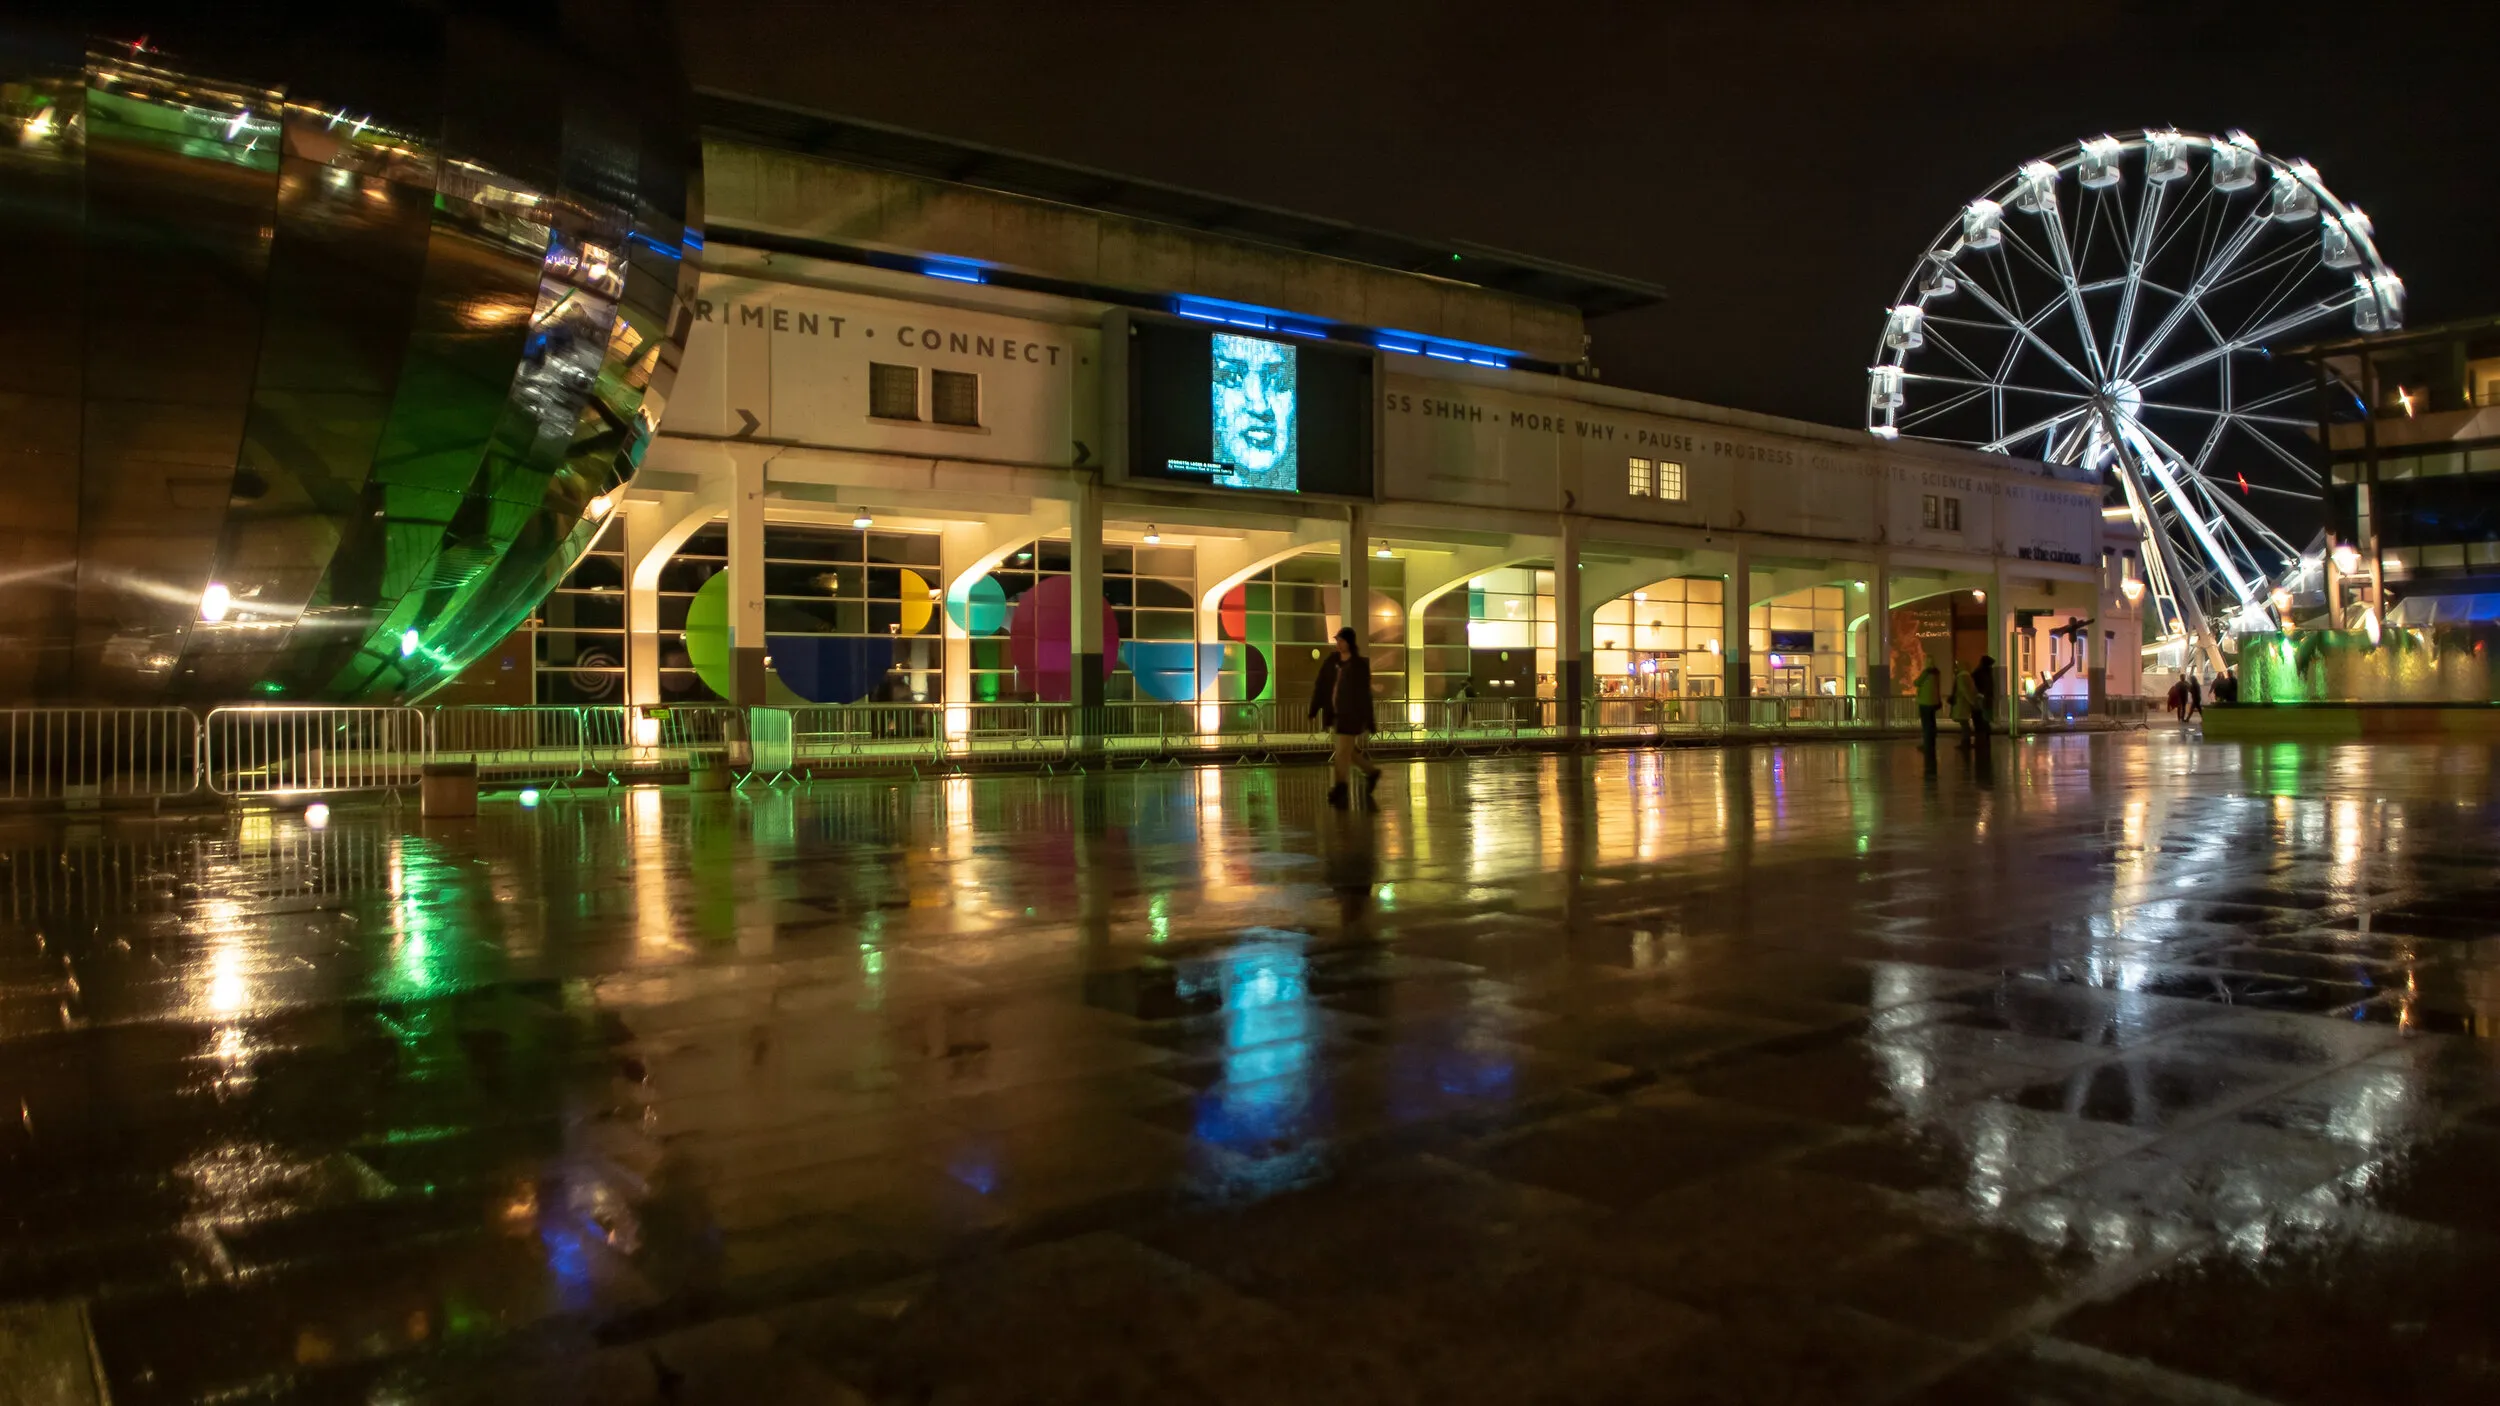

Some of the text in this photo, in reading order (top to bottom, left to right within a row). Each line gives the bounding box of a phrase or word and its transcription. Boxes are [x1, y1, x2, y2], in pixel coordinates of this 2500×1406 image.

[897, 326, 1061, 365] CONNECT
[1386, 394, 1411, 413] SS
[1422, 399, 1482, 423] SHHH
[1511, 411, 1565, 433] MORE
[1575, 420, 1615, 440] WHY
[1638, 430, 1693, 451] PAUSE
[1714, 441, 1794, 465] PROGRESS
[1922, 472, 1972, 492] SCIENCE
[1977, 481, 2000, 496] AND
[2033, 545, 2049, 561] the
[2050, 548, 2082, 565] curious
